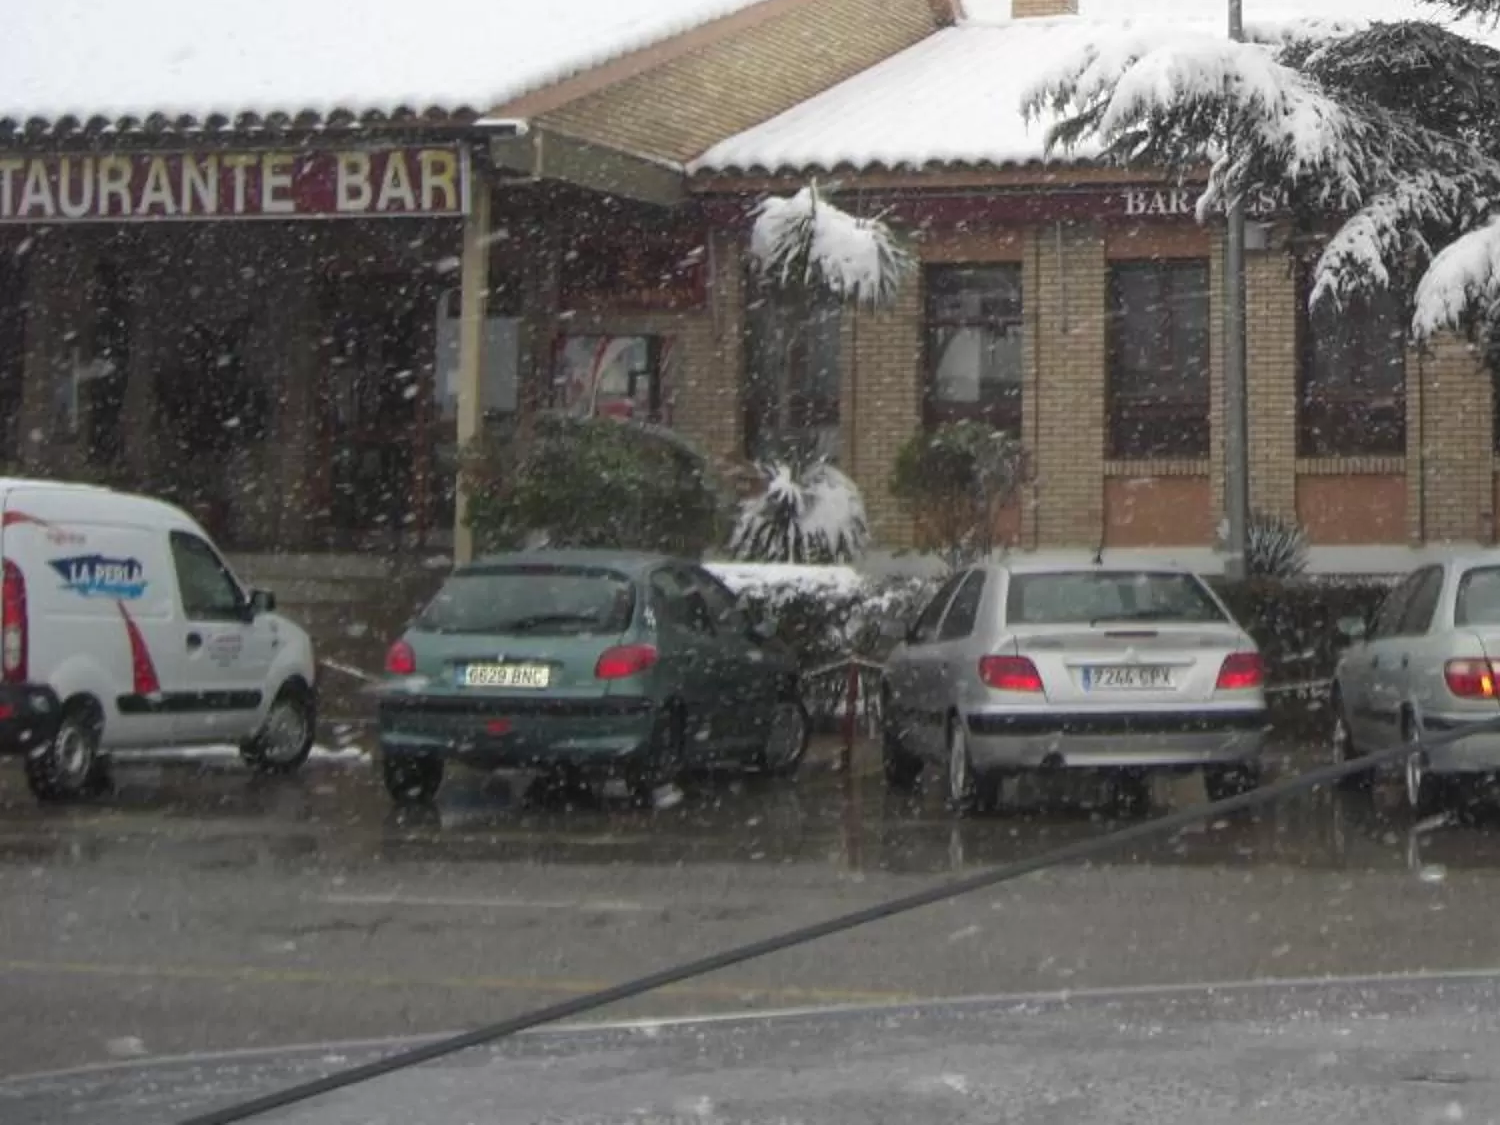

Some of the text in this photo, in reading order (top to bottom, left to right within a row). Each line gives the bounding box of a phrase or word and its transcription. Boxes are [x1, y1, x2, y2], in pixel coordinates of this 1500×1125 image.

[335, 148, 458, 211] BAR
[70, 561, 143, 584] LA PERLA
